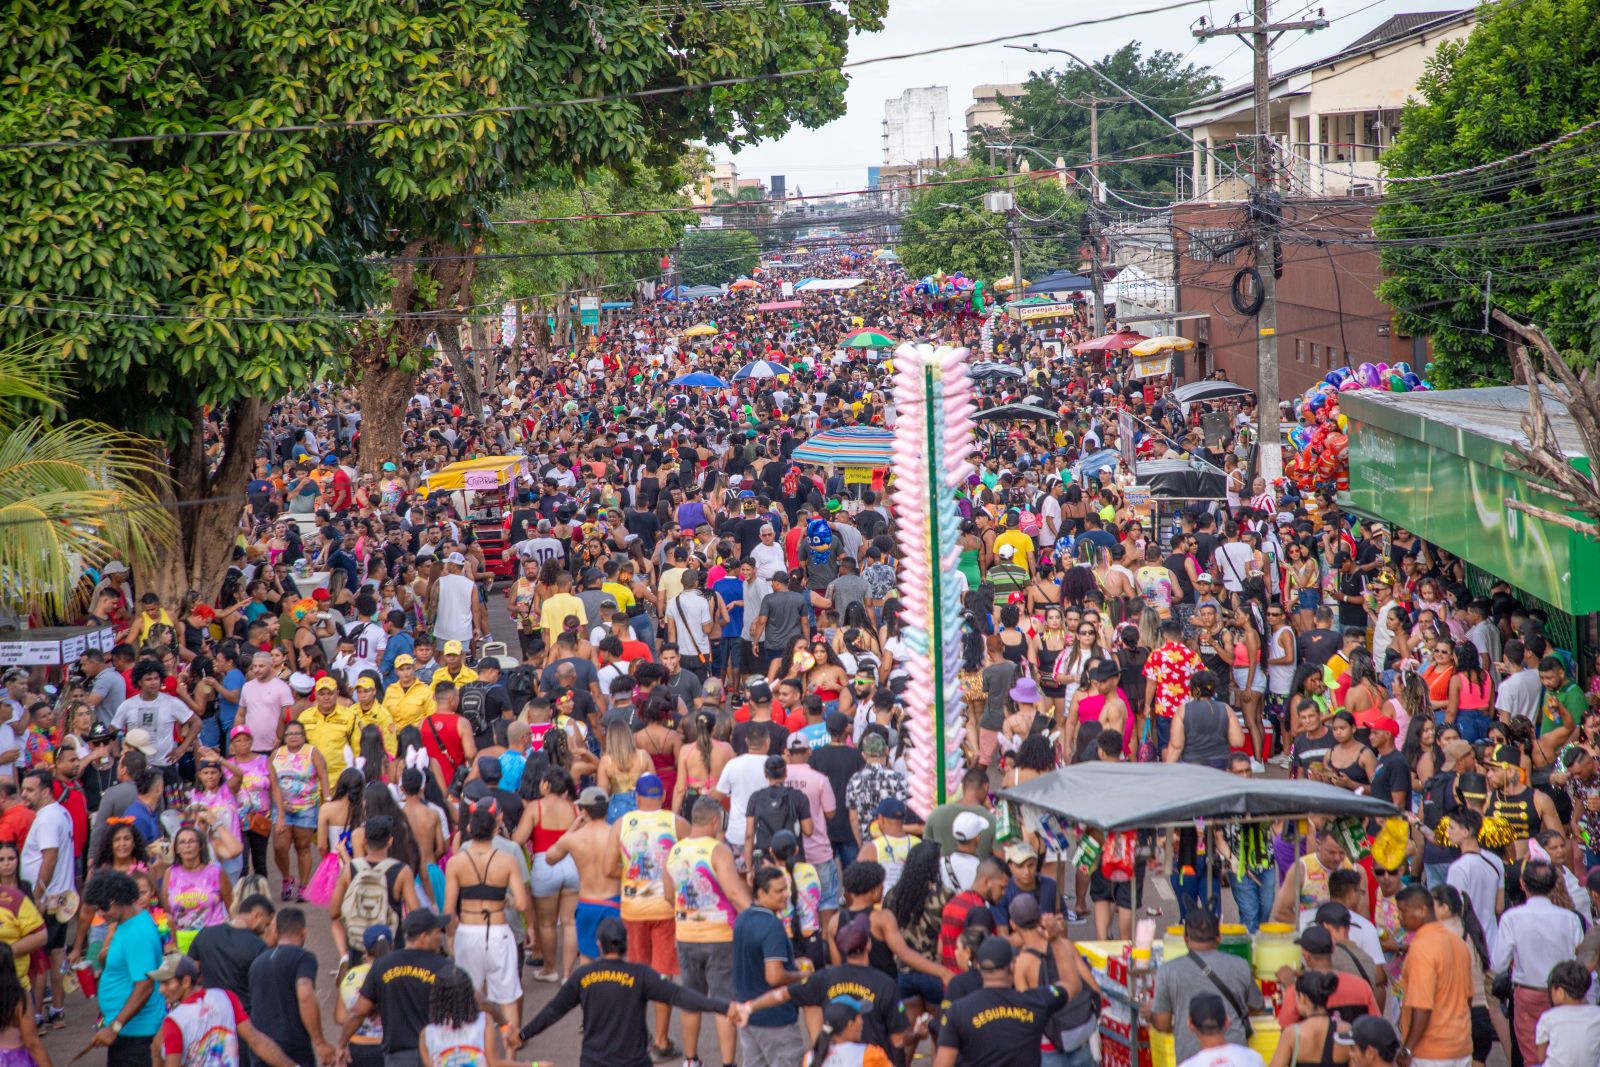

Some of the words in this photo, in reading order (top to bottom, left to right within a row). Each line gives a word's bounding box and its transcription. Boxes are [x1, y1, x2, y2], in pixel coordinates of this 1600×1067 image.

[1021, 306, 1053, 315] Cerveja
[1054, 304, 1073, 312] Suja
[536, 547, 554, 567] 10
[382, 965, 436, 984] SEGURANÇA
[580, 970, 635, 988] SEGURANÇA
[827, 982, 875, 1003] SEGURANÇA
[972, 1006, 1034, 1029] SEGURANÇA
